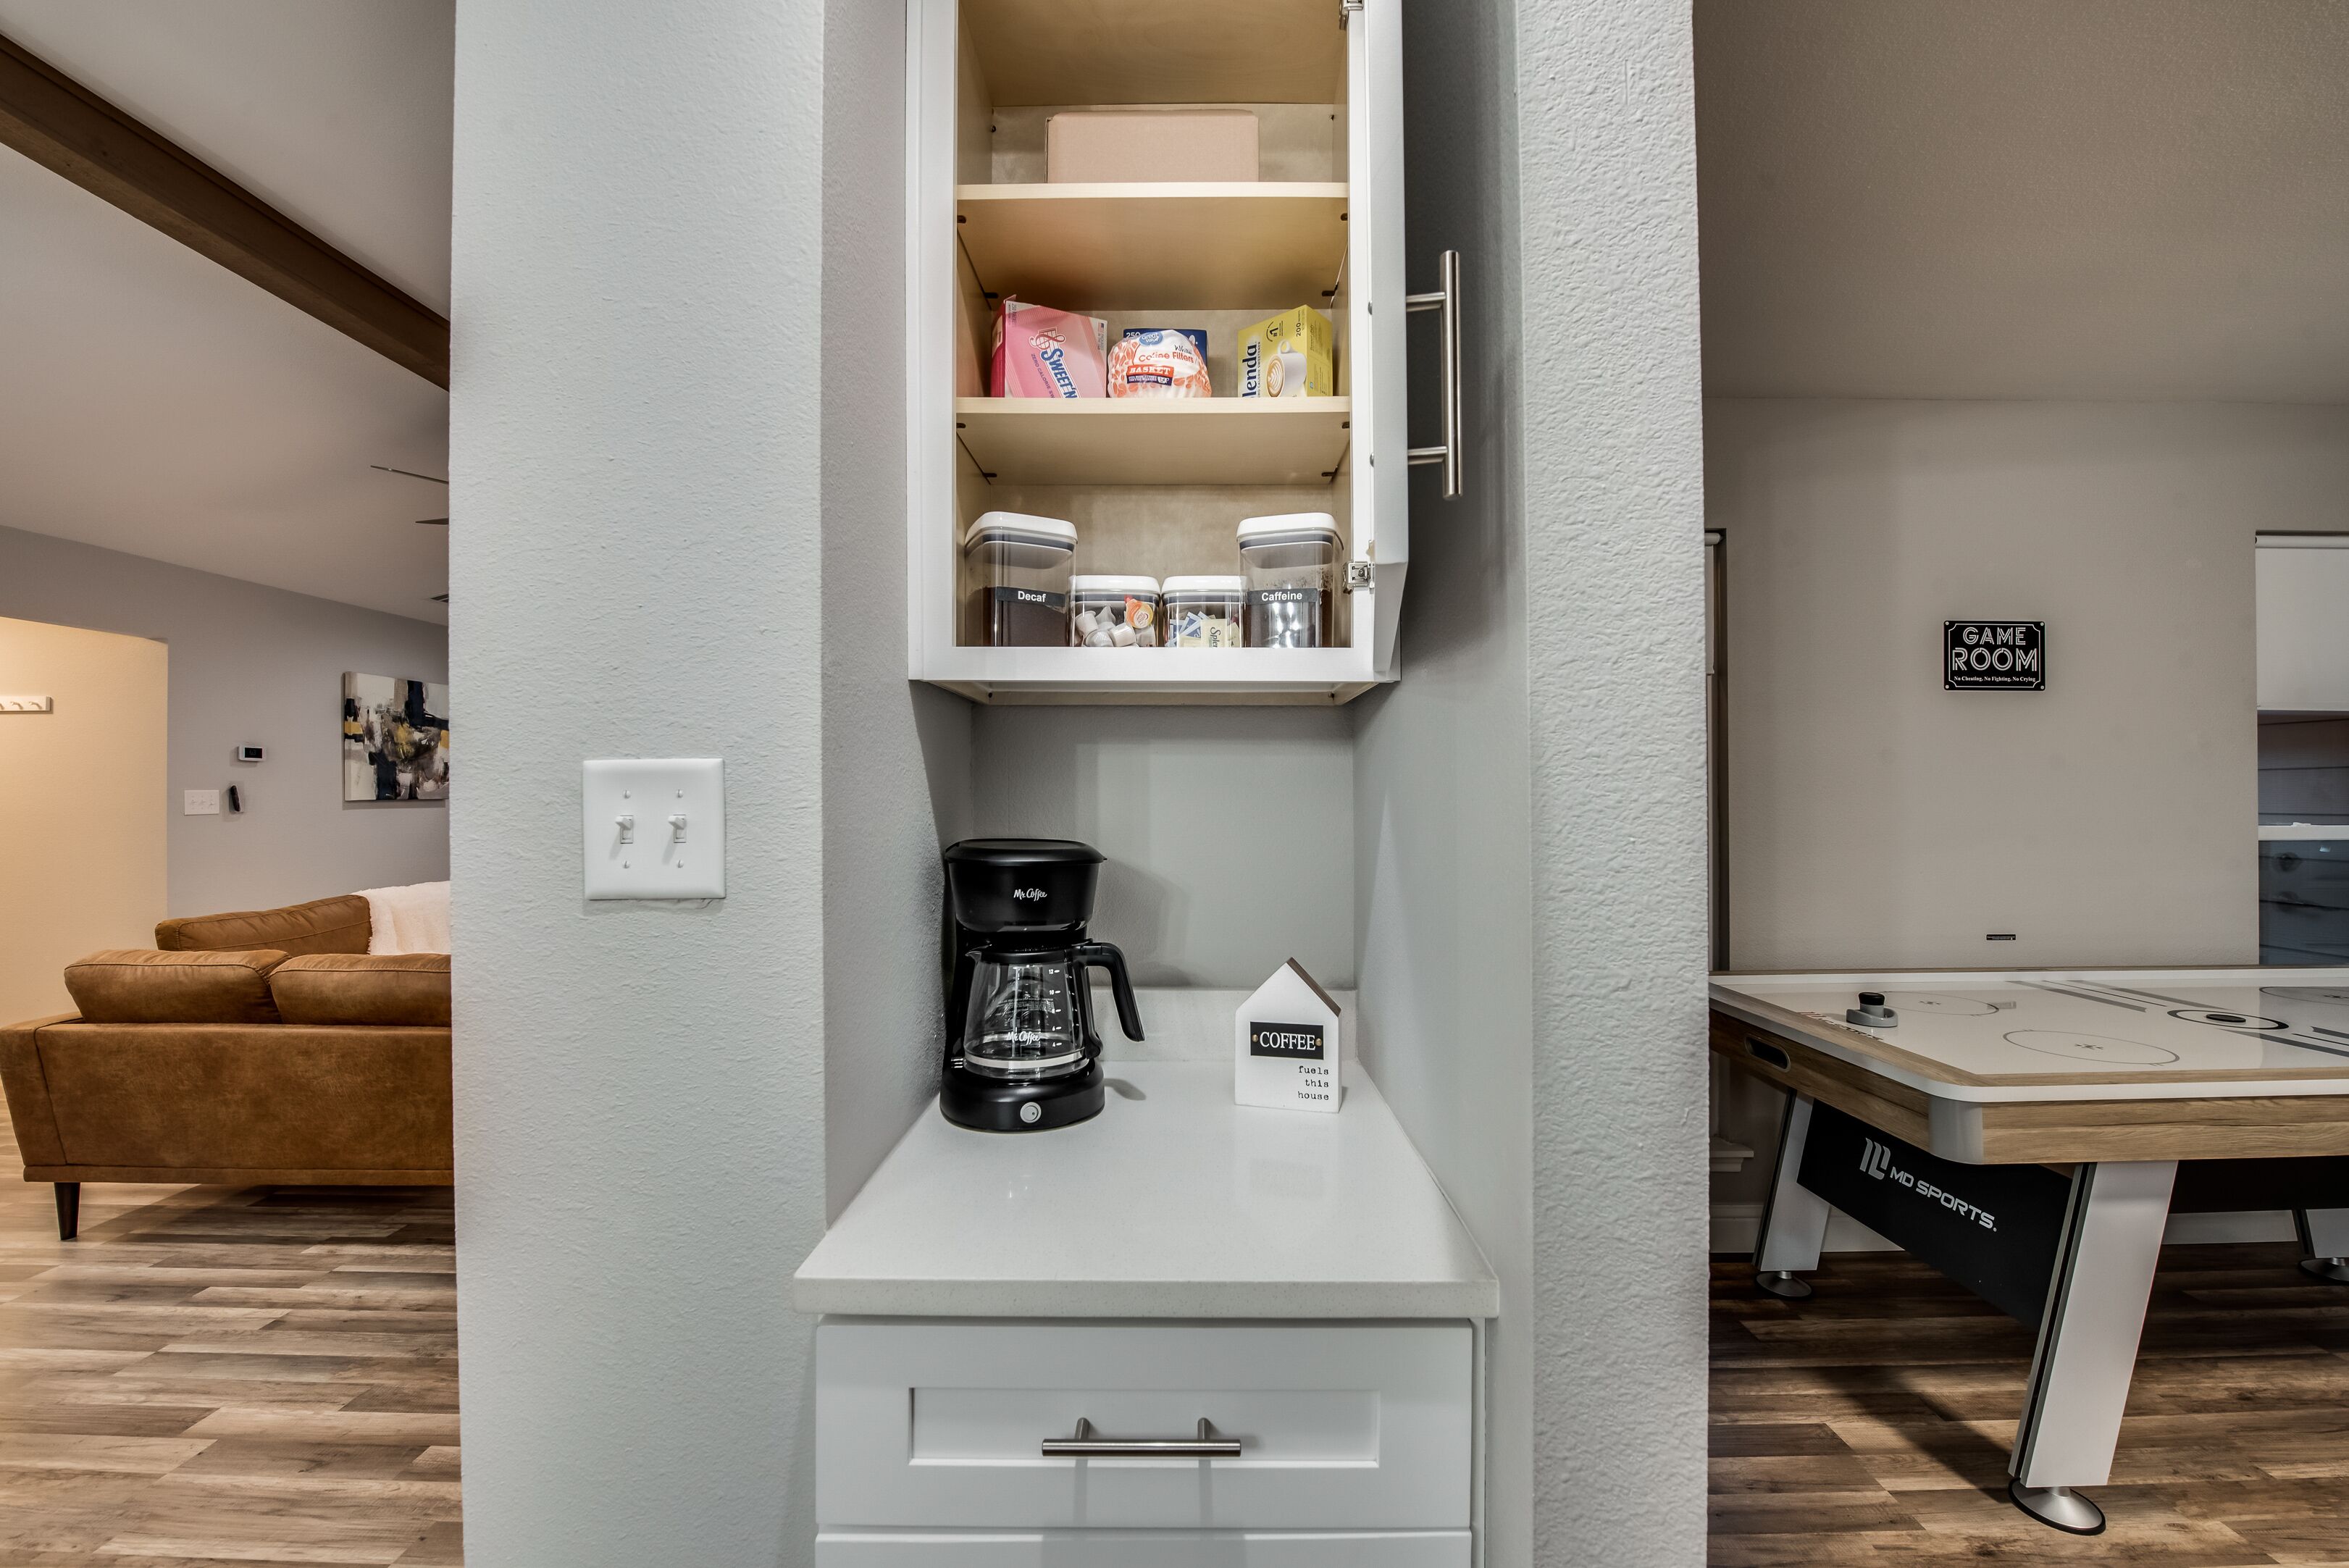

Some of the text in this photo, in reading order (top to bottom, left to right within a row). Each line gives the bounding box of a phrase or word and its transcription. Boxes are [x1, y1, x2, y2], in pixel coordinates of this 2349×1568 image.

[1172, 351, 1194, 364] Filters
[1129, 366, 1171, 375] BASKET
[1242, 344, 1257, 398] lenda
[1037, 367, 1051, 389] CALORIE
[1018, 590, 1047, 602] Decaf
[1261, 591, 1303, 602] Caffeine
[1962, 626, 2026, 645] GAME
[1952, 647, 2038, 671] ROOM
[1026, 888, 1047, 902] Coffee
[1018, 1031, 1041, 1045] Coffee
[1259, 1031, 1316, 1051] COFFEE
[1298, 1065, 1329, 1076] fuels
[1305, 1079, 1329, 1088] this
[1297, 1091, 1329, 1101] house
[1890, 1166, 1914, 1188] MD
